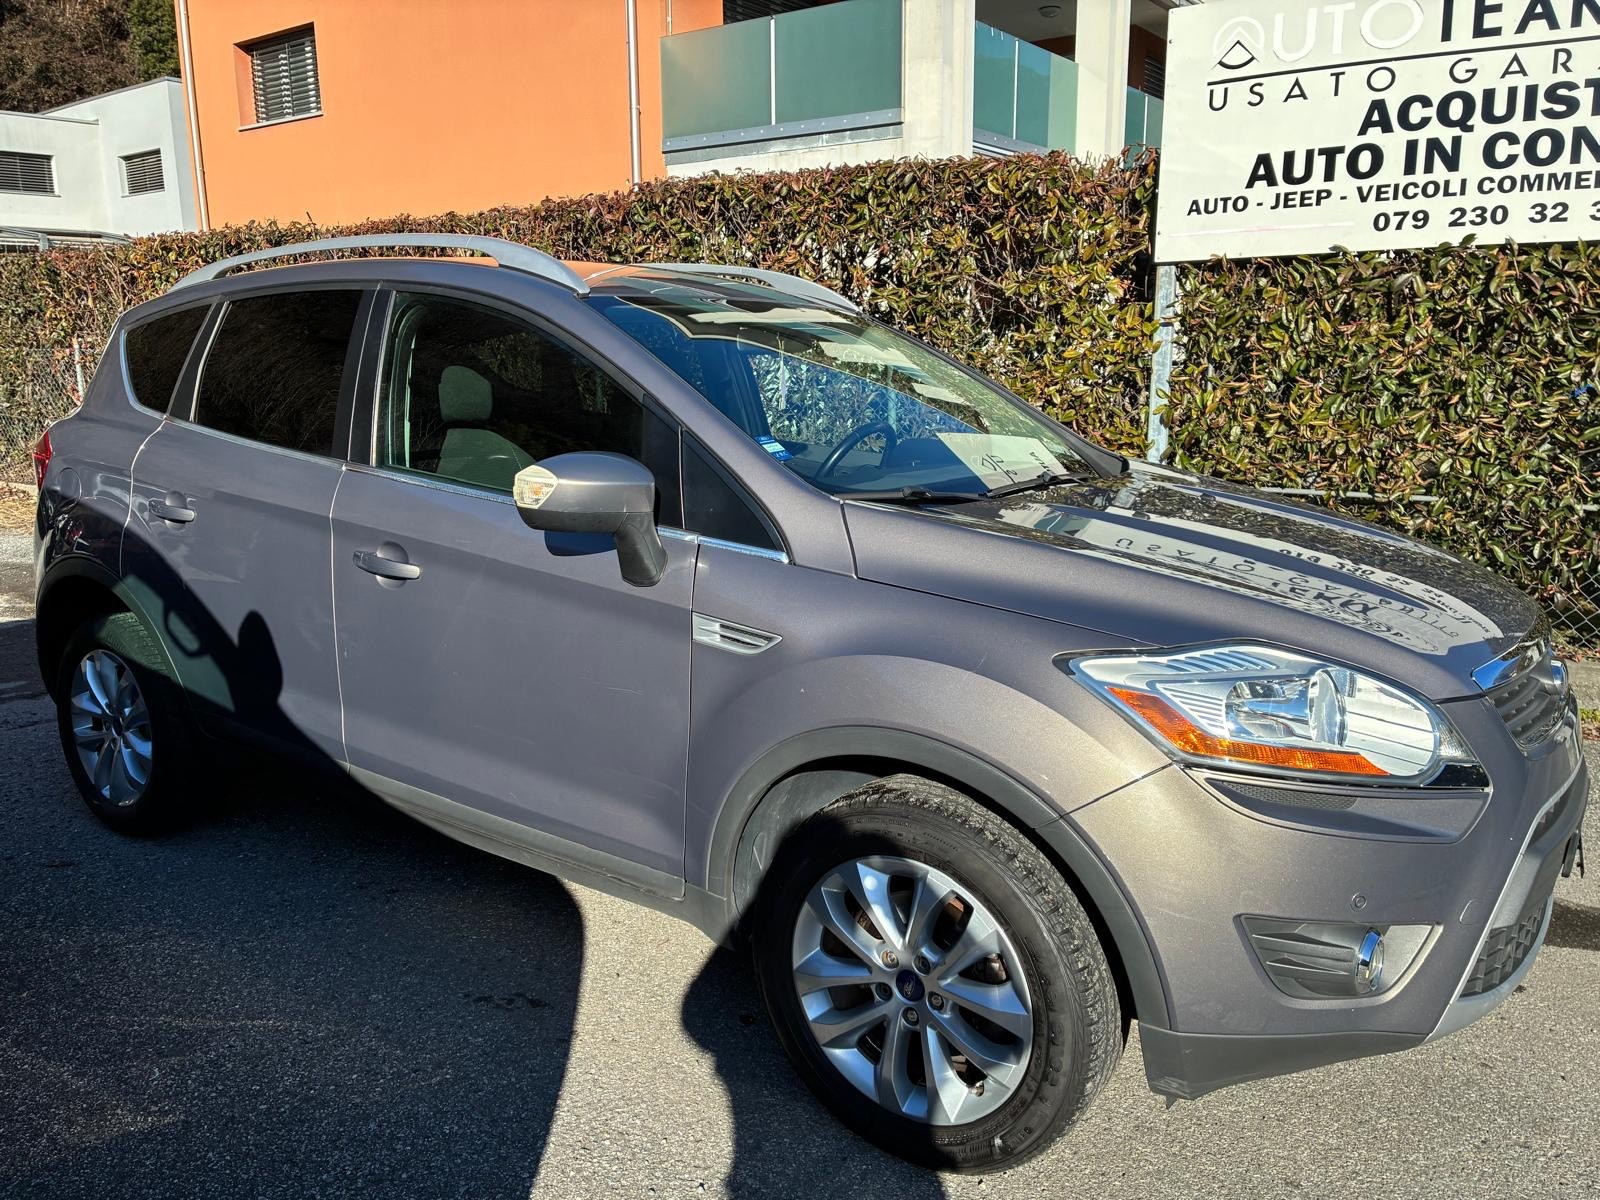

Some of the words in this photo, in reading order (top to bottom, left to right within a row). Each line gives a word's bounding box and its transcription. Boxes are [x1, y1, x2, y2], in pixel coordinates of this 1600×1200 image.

[1209, 65, 1396, 112] USATO
[1449, 48, 1600, 84] GAR
[1245, 143, 1384, 189] AUTO
[1403, 135, 1462, 176] IN
[1482, 126, 1600, 170] CON
[1187, 195, 1249, 216] AUTO
[1269, 189, 1332, 210] JEEP
[1356, 178, 1467, 203] VEICOLI
[1373, 210, 1430, 232] 079
[1448, 205, 1509, 228] 230
[1528, 202, 1569, 223] 32
